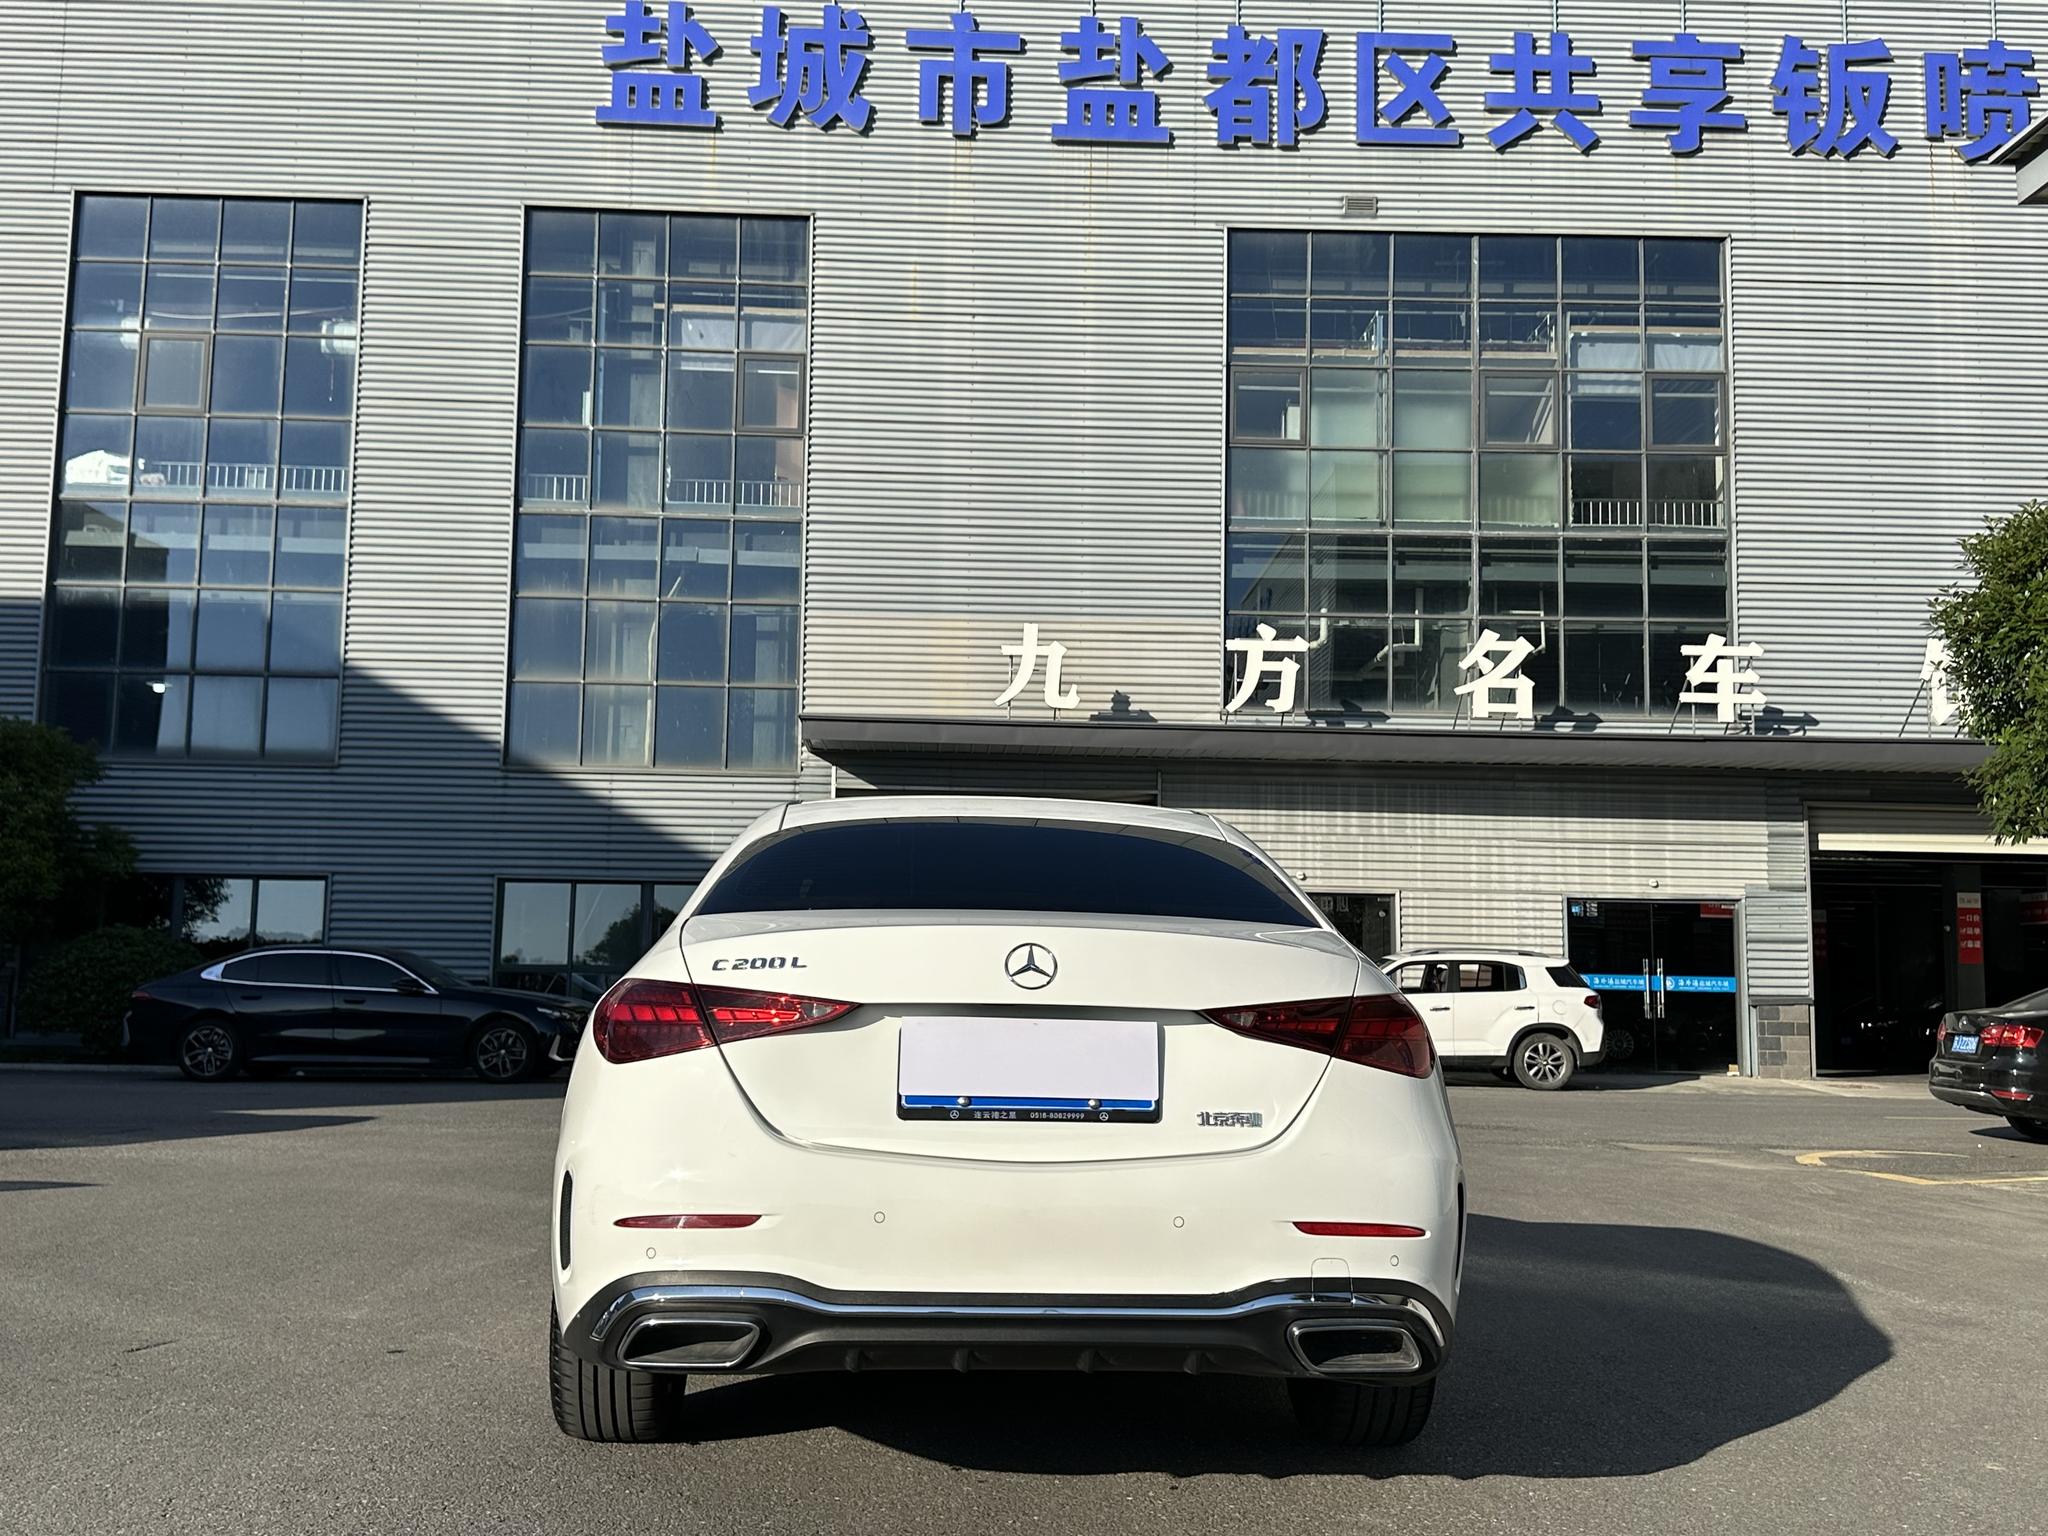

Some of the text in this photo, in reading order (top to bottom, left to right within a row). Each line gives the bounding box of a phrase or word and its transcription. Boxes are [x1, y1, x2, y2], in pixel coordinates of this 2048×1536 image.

[596, 1, 2038, 161] 盐城市盐都区共享钣喷
